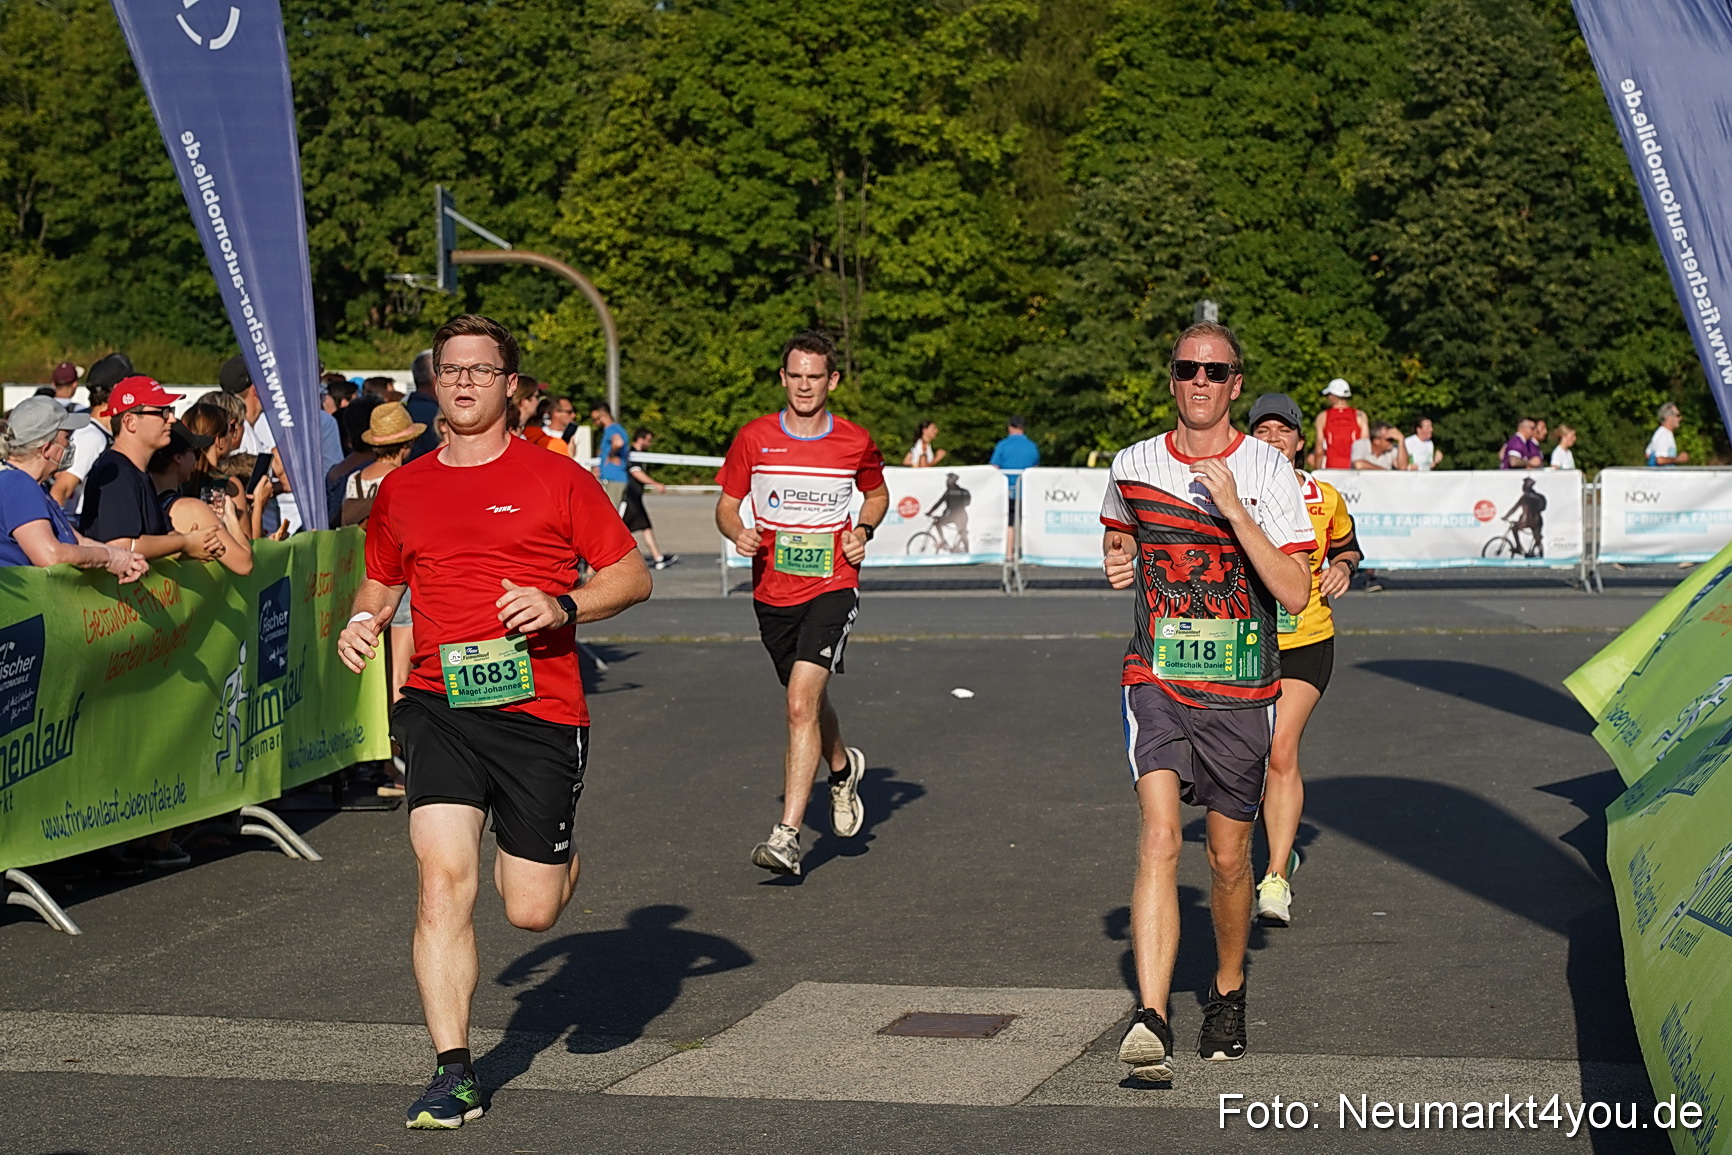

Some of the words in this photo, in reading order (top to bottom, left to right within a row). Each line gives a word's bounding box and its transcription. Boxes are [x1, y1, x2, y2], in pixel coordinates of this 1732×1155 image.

[783, 489, 838, 506] Petry
[1044, 490, 1079, 502] NOW
[1625, 491, 1661, 503] NOW
[785, 547, 824, 562] 1237
[1158, 645, 1167, 667] RUN
[1175, 640, 1217, 660] 118
[1225, 643, 1233, 671] 2022
[0, 655, 36, 680] ischer
[458, 660, 518, 687] 1683
[1165, 661, 1202, 669] Gottschalk
[518, 660, 530, 690] 2022
[448, 673, 460, 696] RUN
[459, 686, 482, 697] Maget
[483, 682, 522, 695] Johannes
[553, 840, 569, 852] JAKO
